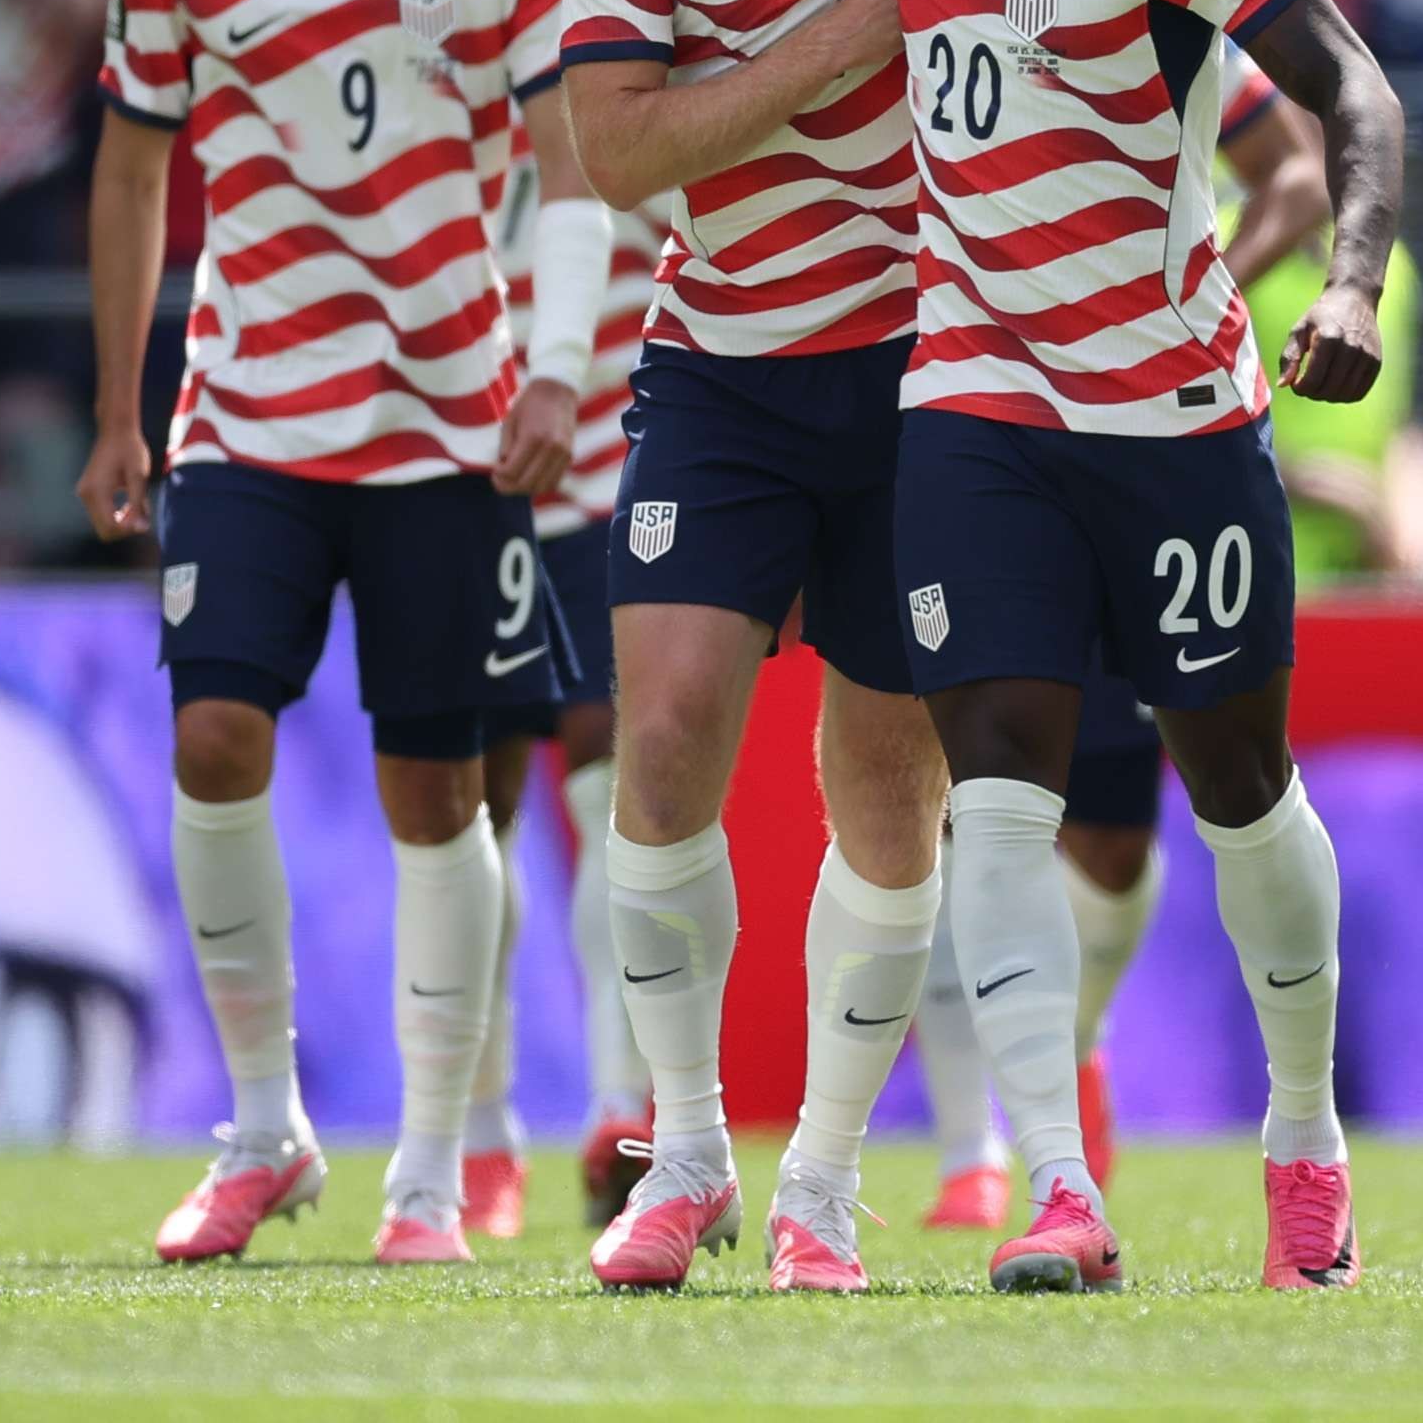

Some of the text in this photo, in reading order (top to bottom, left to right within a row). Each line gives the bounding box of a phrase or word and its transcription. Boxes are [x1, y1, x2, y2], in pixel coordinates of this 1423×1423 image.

[341, 61, 376, 152] 9
[927, 33, 1002, 141] 20
[634, 504, 674, 528] USA
[495, 536, 534, 639] 9
[911, 587, 941, 615] USA
[1153, 524, 1253, 635] 20
